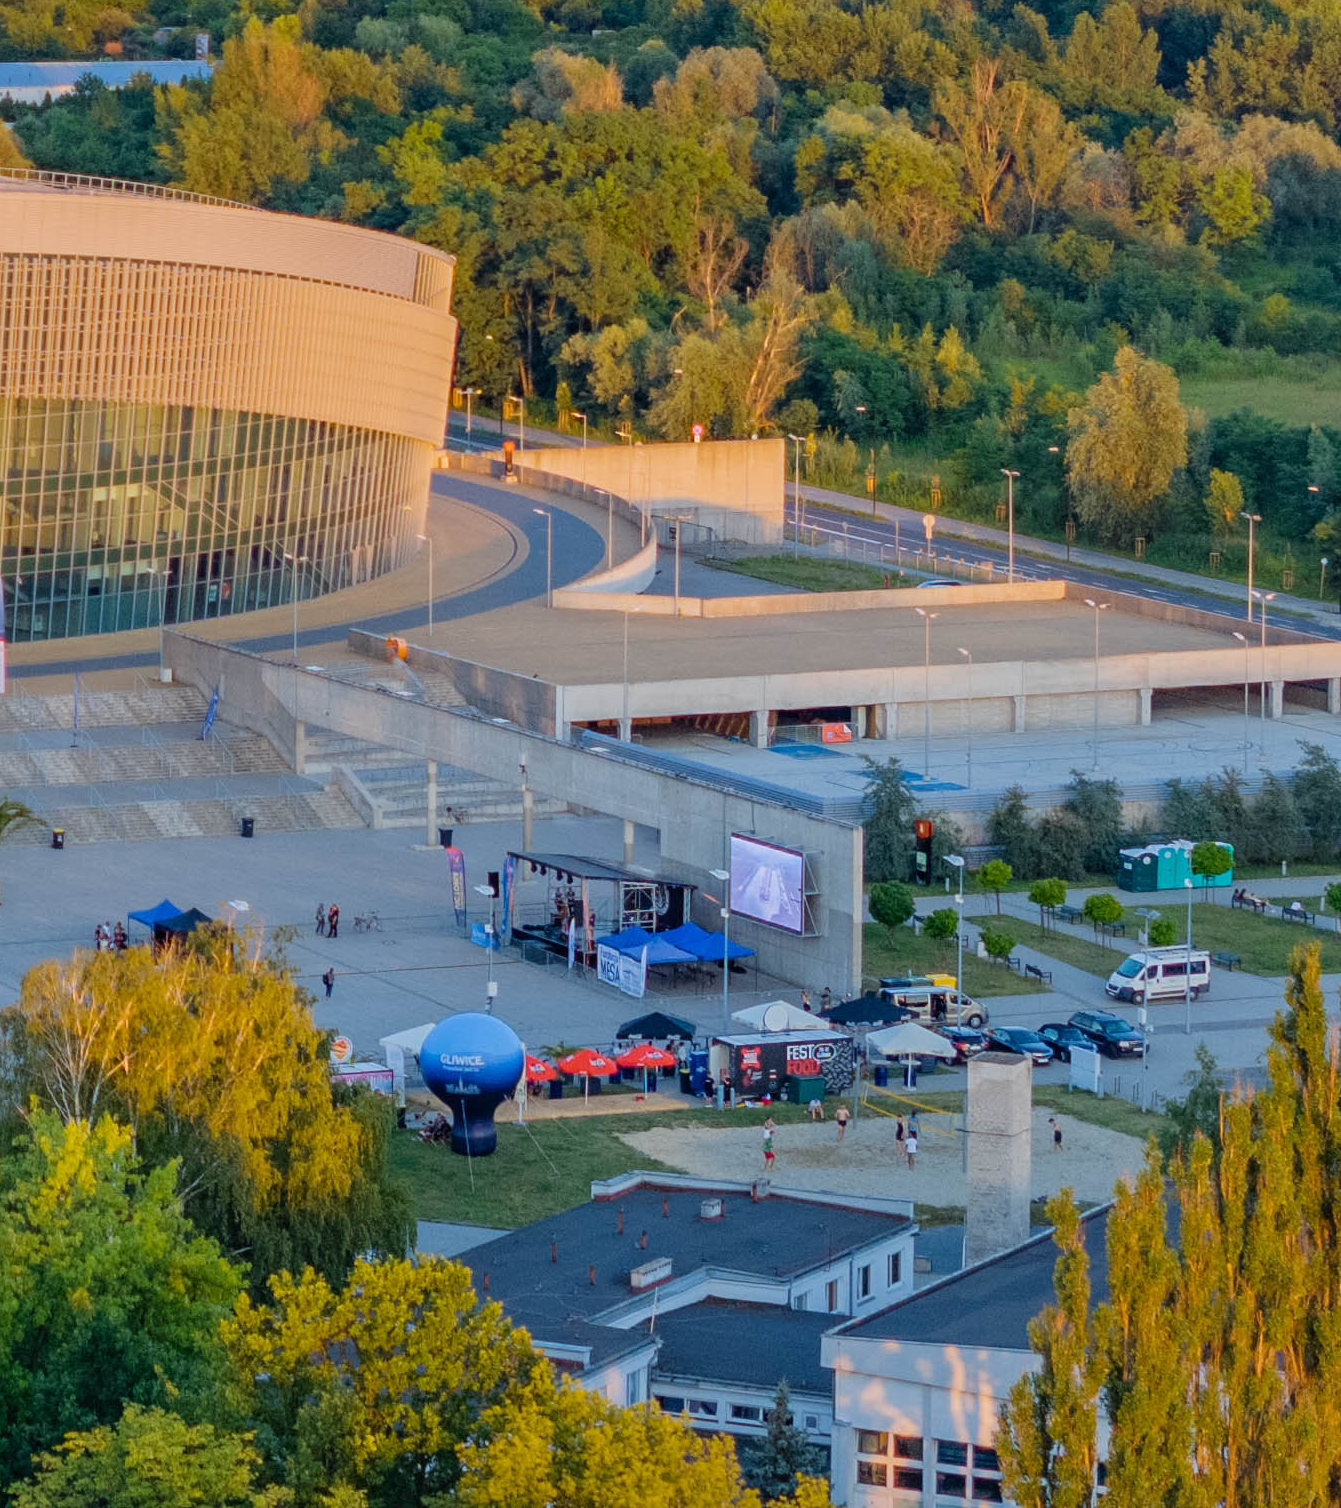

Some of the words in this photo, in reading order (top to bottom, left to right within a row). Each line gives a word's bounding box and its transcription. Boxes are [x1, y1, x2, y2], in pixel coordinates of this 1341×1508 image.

[439, 1053, 484, 1066] GLIWICE
[786, 1044, 815, 1061] FEST
[786, 1060, 822, 1075] FOOD
